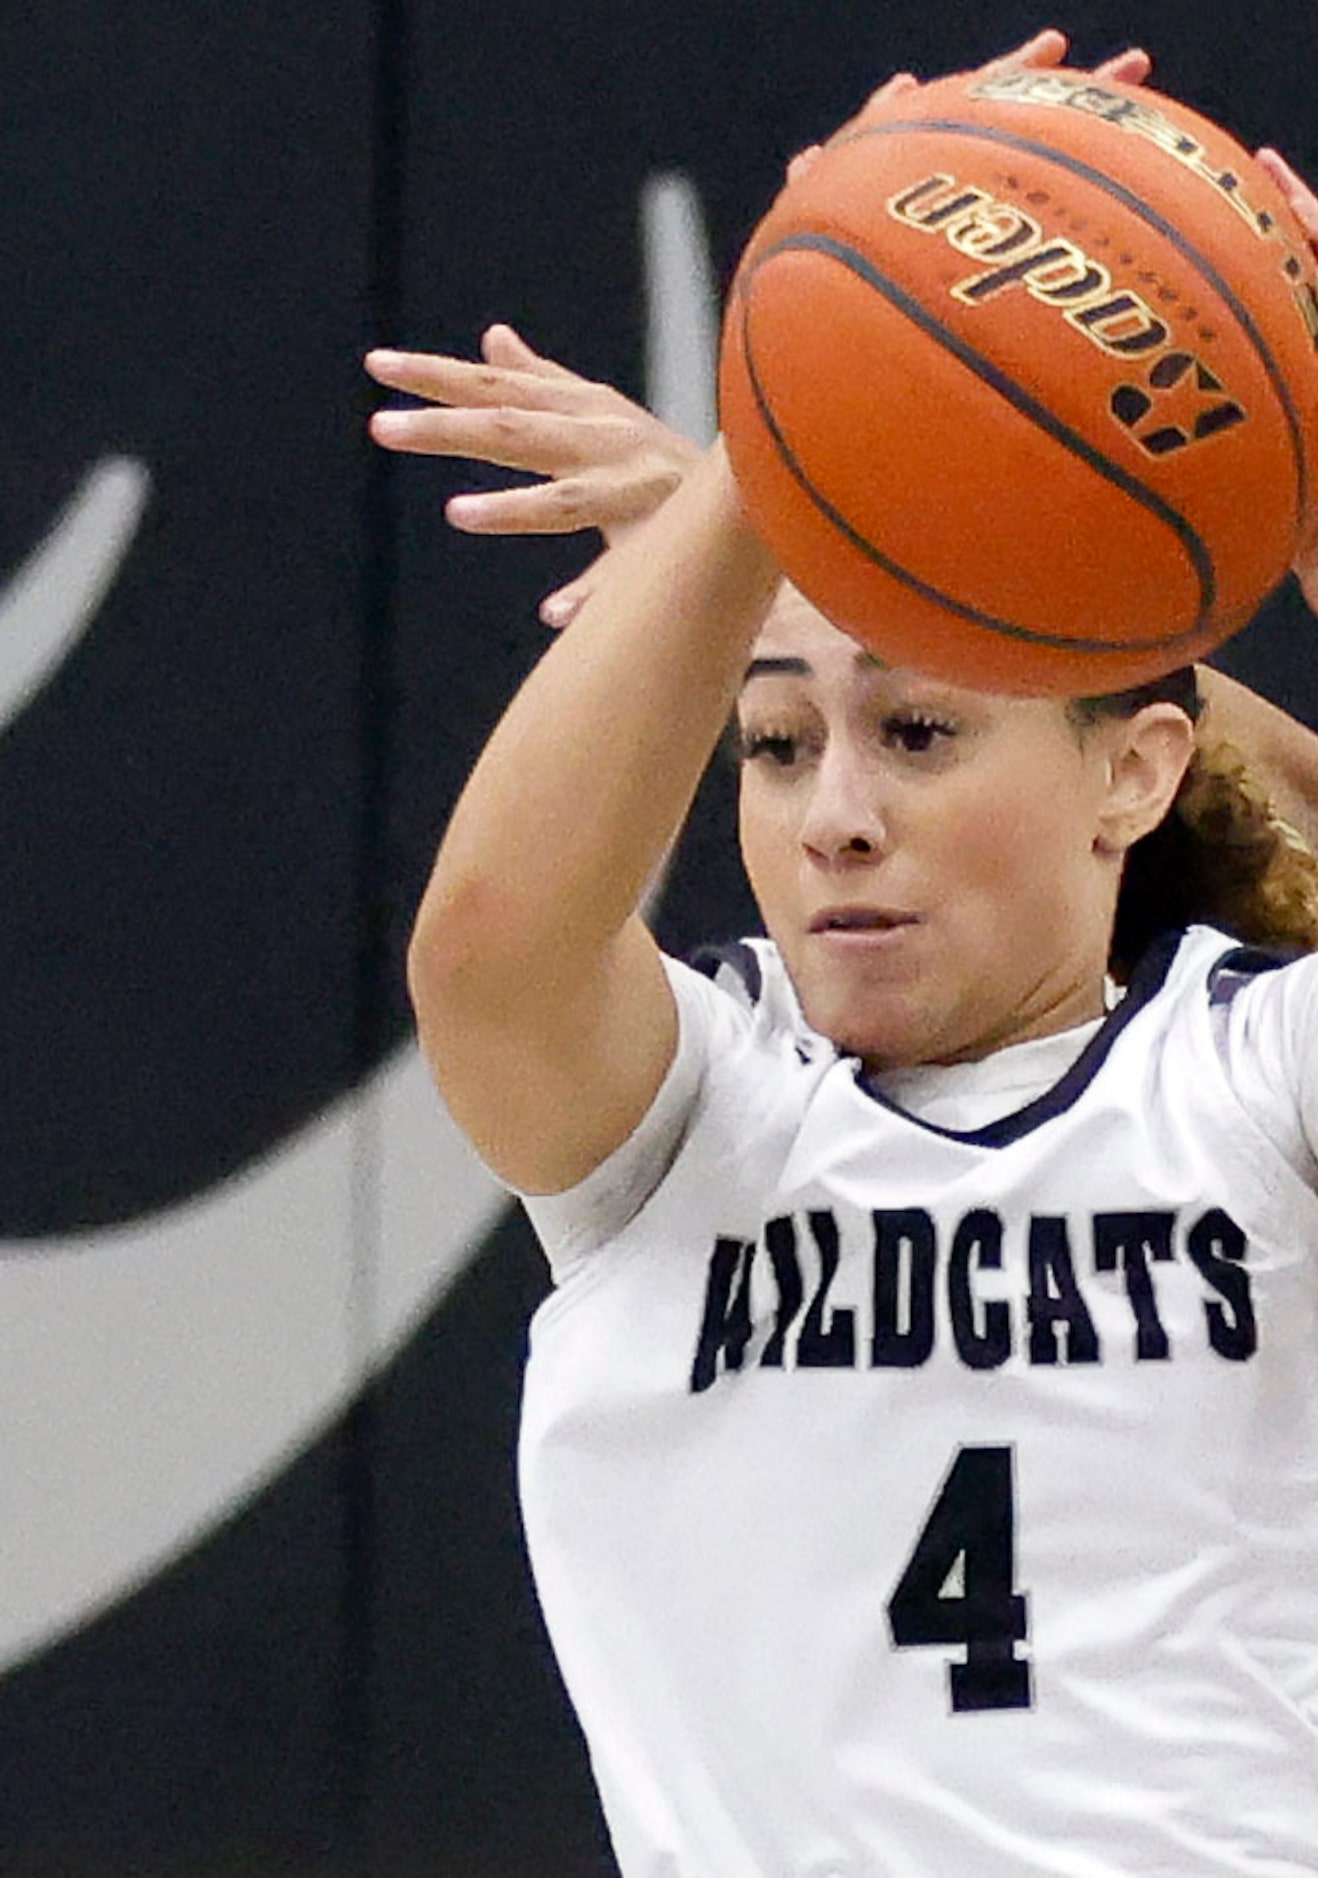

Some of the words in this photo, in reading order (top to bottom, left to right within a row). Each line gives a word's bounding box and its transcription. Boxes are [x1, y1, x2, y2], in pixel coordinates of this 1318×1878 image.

[885, 172, 1248, 462] Baden
[689, 1206, 1258, 1395] WILDCATS
[884, 1441, 1034, 1716] 4
